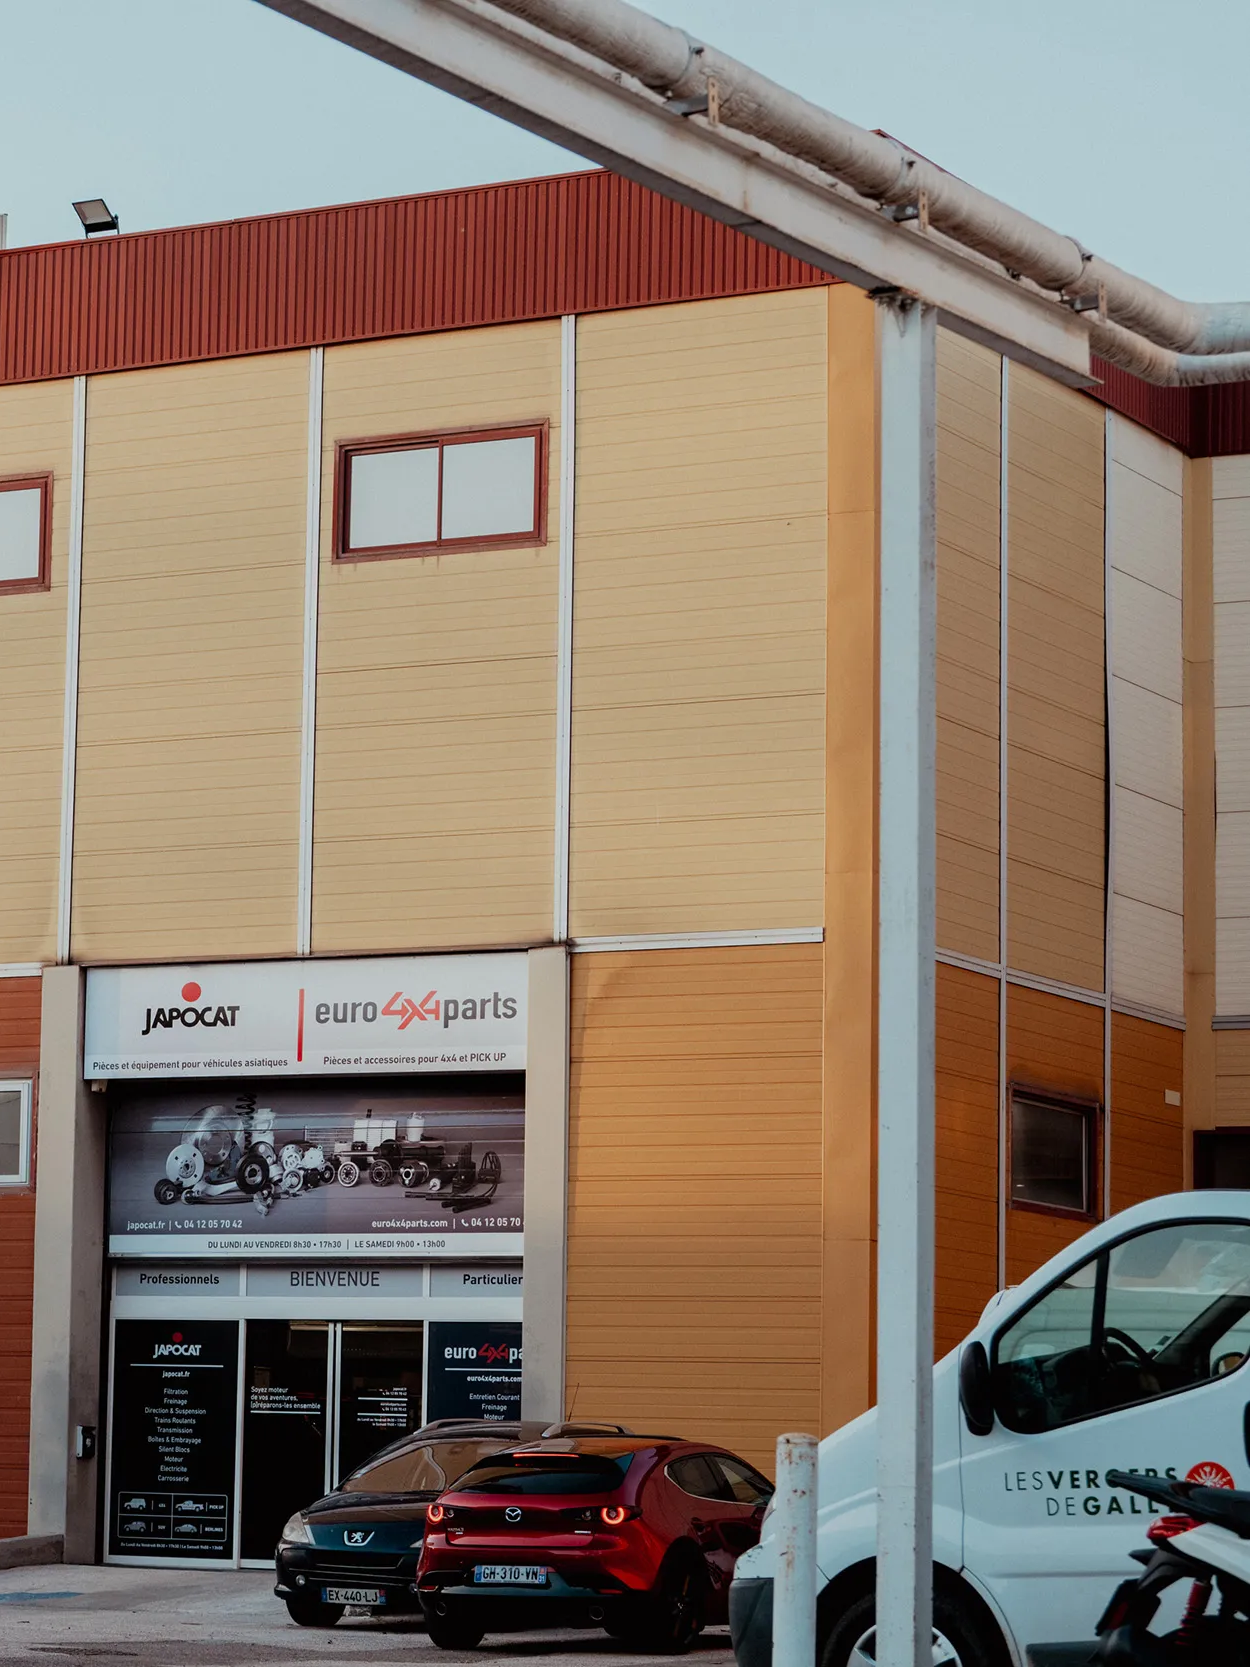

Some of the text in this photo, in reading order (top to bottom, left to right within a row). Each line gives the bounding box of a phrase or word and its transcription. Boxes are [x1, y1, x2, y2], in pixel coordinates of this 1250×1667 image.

[141, 1005, 240, 1036] JAPOCAT
[92, 1058, 288, 1072] Pièces et équipement pour véhicules asiatiques
[323, 1052, 507, 1066] Pièces et accessoires pour 4x4 et PICK UP
[127, 1220, 242, 1232] japocat.fr 04 12 05 70 42
[371, 1218, 448, 1230] euro4x4parts.com
[471, 1218, 482, 1227] 04
[484, 1218, 494, 1227] 12
[496, 1218, 508, 1227] 05
[510, 1218, 521, 1227] 70
[208, 1240, 446, 1249] DU LUNDI AU VENDREDI 8h30 17h30 LE SAMEDI 9h00 13h00
[139, 1273, 220, 1285] Professionnels
[290, 1271, 380, 1287] BIENVENUE
[152, 1344, 202, 1359] JAPOCAT
[162, 1370, 191, 1378] japocat.fr
[163, 1398, 188, 1406] Freinage
[482, 1404, 507, 1412] Freinage
[144, 1406, 169, 1414] Direction
[154, 1416, 196, 1424] Trains Roulants
[156, 1426, 193, 1434] Transmission
[170, 1436, 202, 1445] Embrayage
[158, 1474, 190, 1482] Carrosserie
[482, 1567, 538, 1580] GH-310-VN
[328, 1590, 378, 1603] EX-440-LJ
